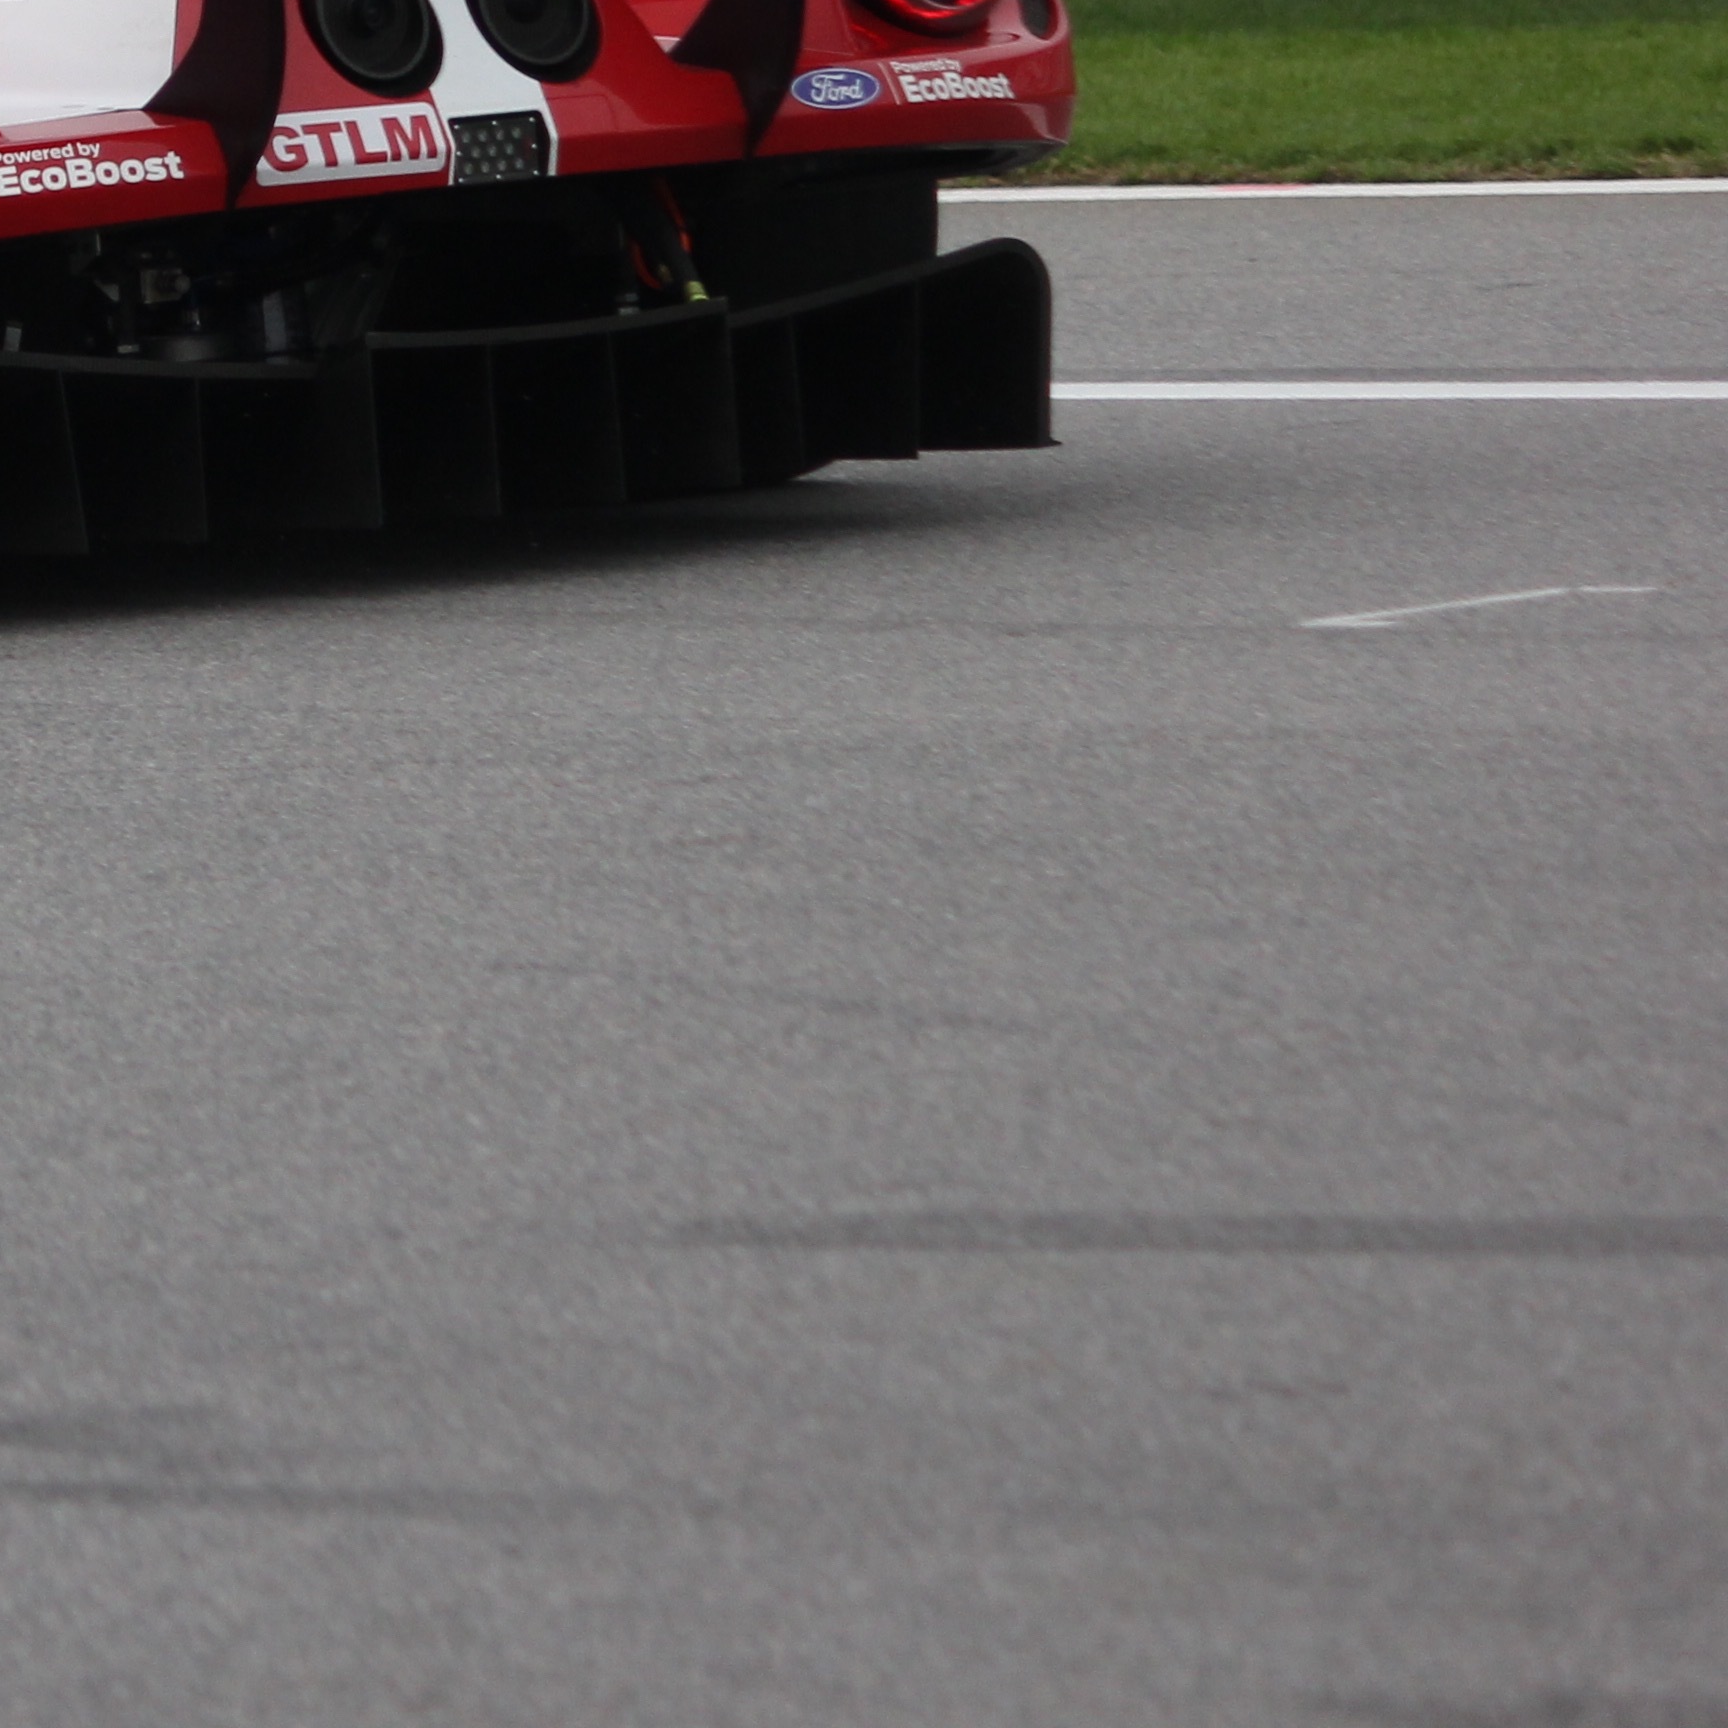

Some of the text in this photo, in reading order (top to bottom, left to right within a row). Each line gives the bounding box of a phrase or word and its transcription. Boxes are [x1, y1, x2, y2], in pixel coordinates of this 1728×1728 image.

[810, 74, 864, 103] Ford
[898, 72, 1016, 103] EcoBoost
[76, 141, 101, 159] by
[263, 114, 438, 173] GTLM
